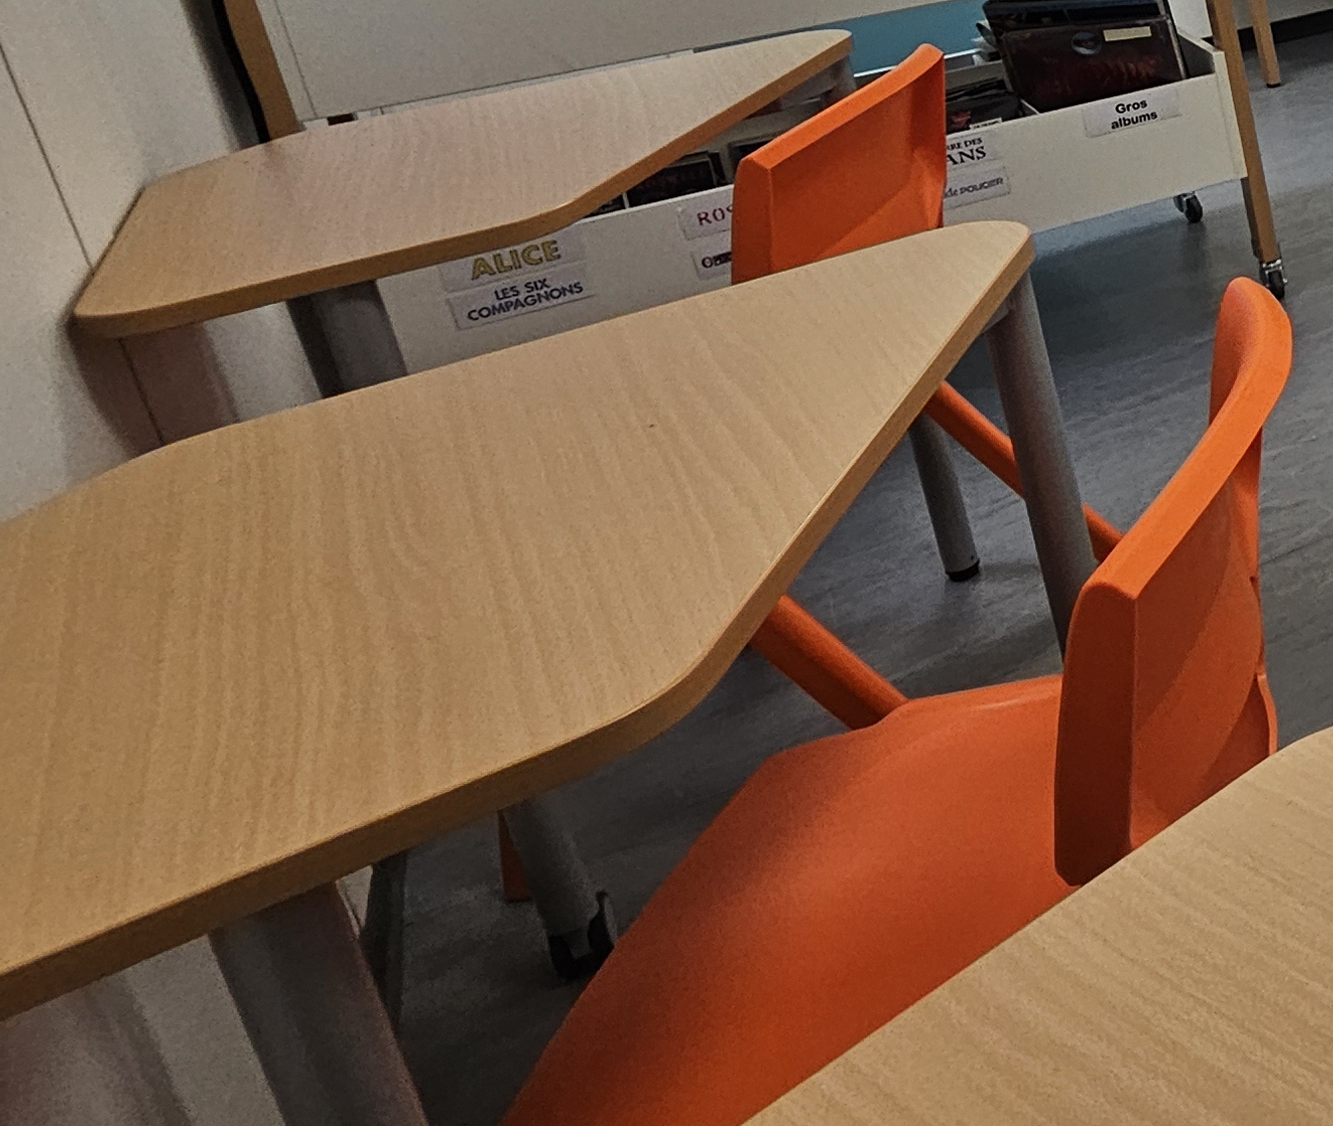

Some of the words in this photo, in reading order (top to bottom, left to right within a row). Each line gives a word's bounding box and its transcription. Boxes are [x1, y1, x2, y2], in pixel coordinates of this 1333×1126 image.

[1116, 100, 1148, 114] Gros
[1111, 112, 1158, 130] albums
[964, 137, 982, 148] DES
[946, 146, 986, 166] ANS
[471, 240, 561, 280] ALICE
[494, 286, 520, 300] LES
[524, 278, 550, 293] SIX
[468, 282, 584, 321] COMPAGNONS
